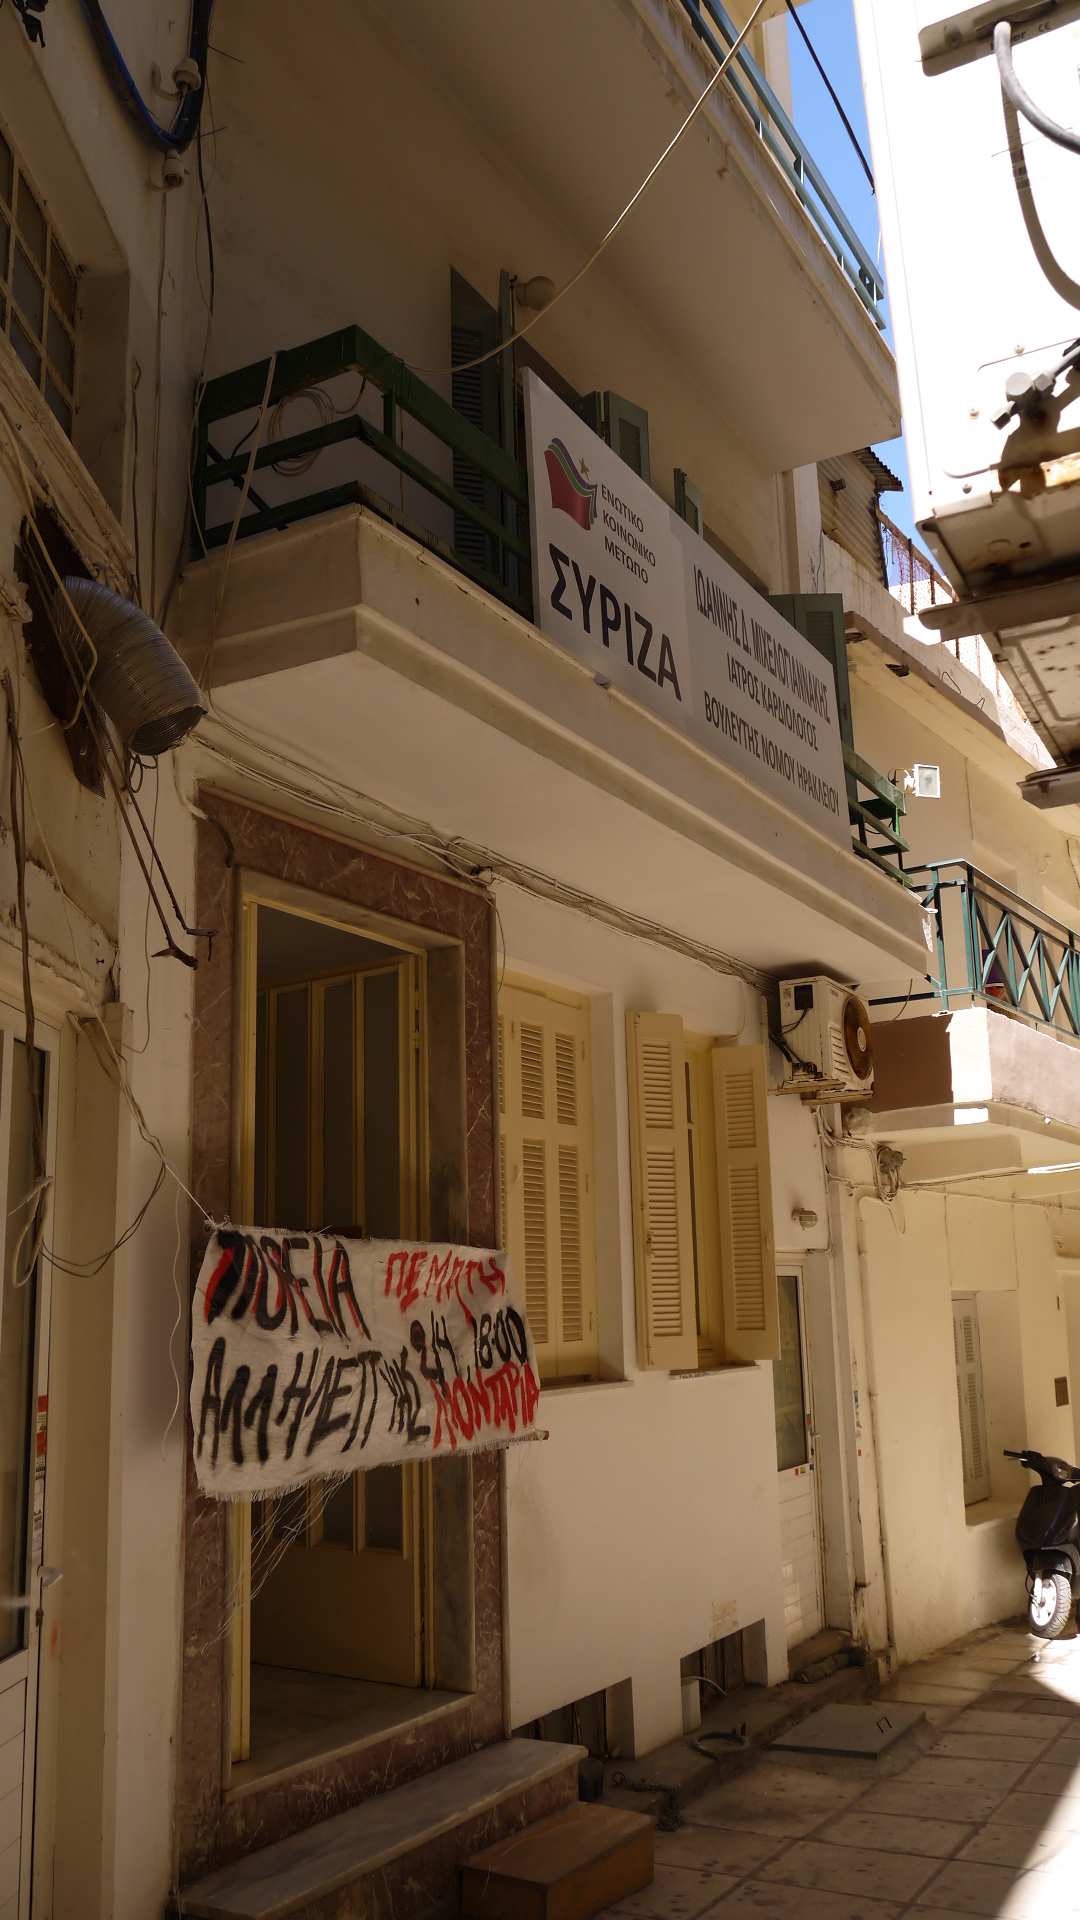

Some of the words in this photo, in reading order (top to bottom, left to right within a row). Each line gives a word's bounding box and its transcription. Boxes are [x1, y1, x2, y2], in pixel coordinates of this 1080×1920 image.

[601, 483, 644, 533] ΕΝΩΤΙΚΟ
[602, 508, 656, 567] ΚΟΙΝΩΝΙΚΟ
[604, 535, 649, 584] ΜΕΤΩΠΟ
[549, 542, 682, 702] ΣΥΡΙΖΑ
[693, 564, 741, 647] ΙΩΑΝΝΗΣ
[741, 608, 752, 657] Δ.
[751, 617, 831, 725] ΜΙΧΕΛΟΓΙΑΝΝΑΚΗΣ
[727, 652, 761, 705] ΙΑΤΡΟΣ
[761, 681, 819, 752] ΚΑΡΔΙΟΛΟΓΟΣ
[704, 690, 761, 759] ΒΟΥΛΕΥΤΗΣ
[761, 734, 796, 785] ΝΟΜΟΥ
[796, 761, 840, 817] ΗΡΑΚΛΕΙΟΥ
